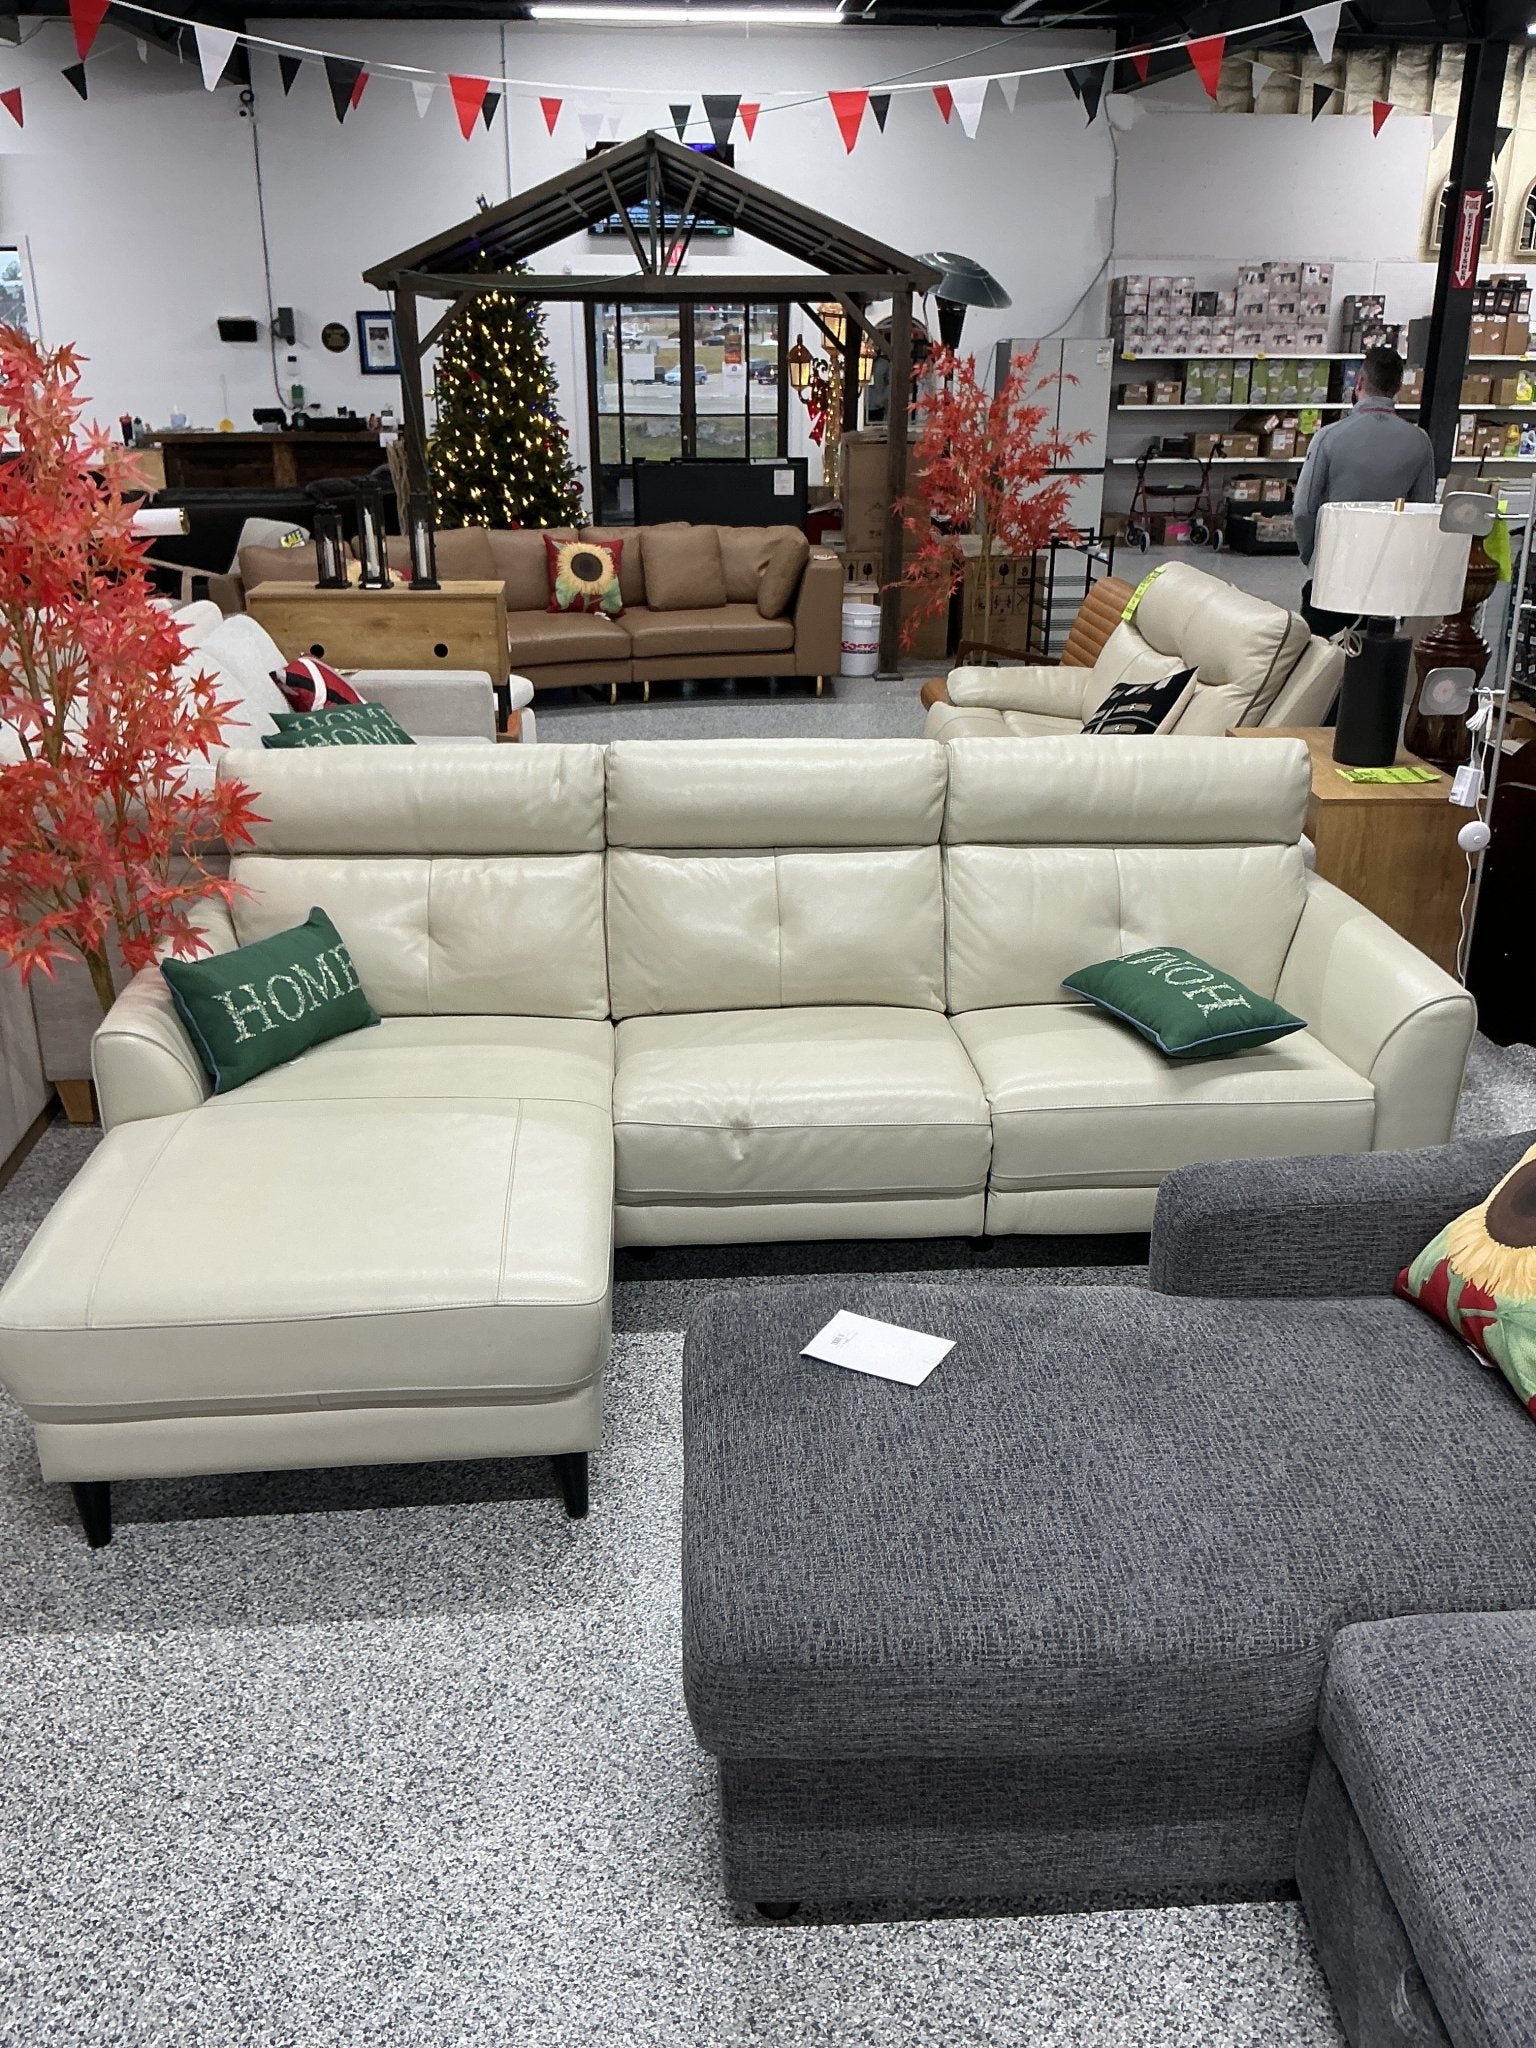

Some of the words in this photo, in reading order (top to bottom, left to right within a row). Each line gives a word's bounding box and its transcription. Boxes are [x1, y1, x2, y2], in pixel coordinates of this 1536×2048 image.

[1466, 201, 1480, 210] FIRE
[1460, 213, 1474, 281] EXTINGUISHER
[1117, 948, 1251, 1018] HOM
